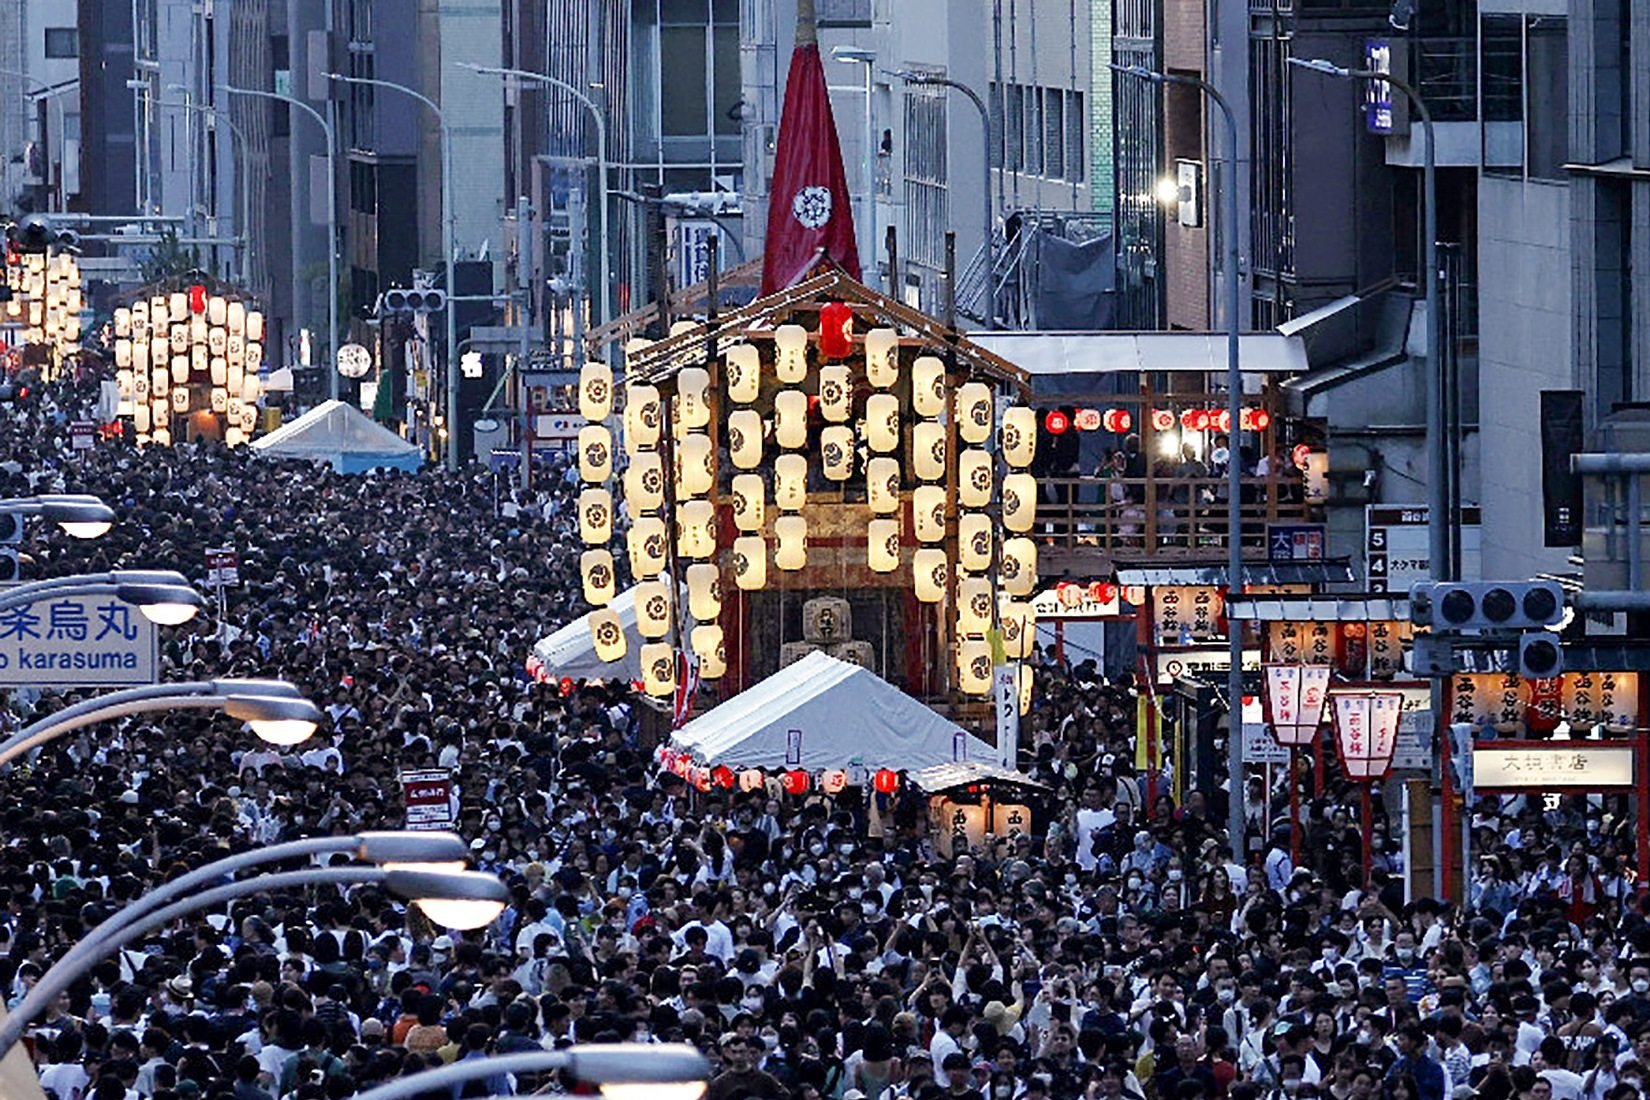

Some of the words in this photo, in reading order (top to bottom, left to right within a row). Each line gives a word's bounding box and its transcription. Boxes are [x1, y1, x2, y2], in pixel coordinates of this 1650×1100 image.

[1371, 532, 1384, 546] 5
[1371, 559, 1384, 571] 4
[19, 648, 137, 670] karasuma
